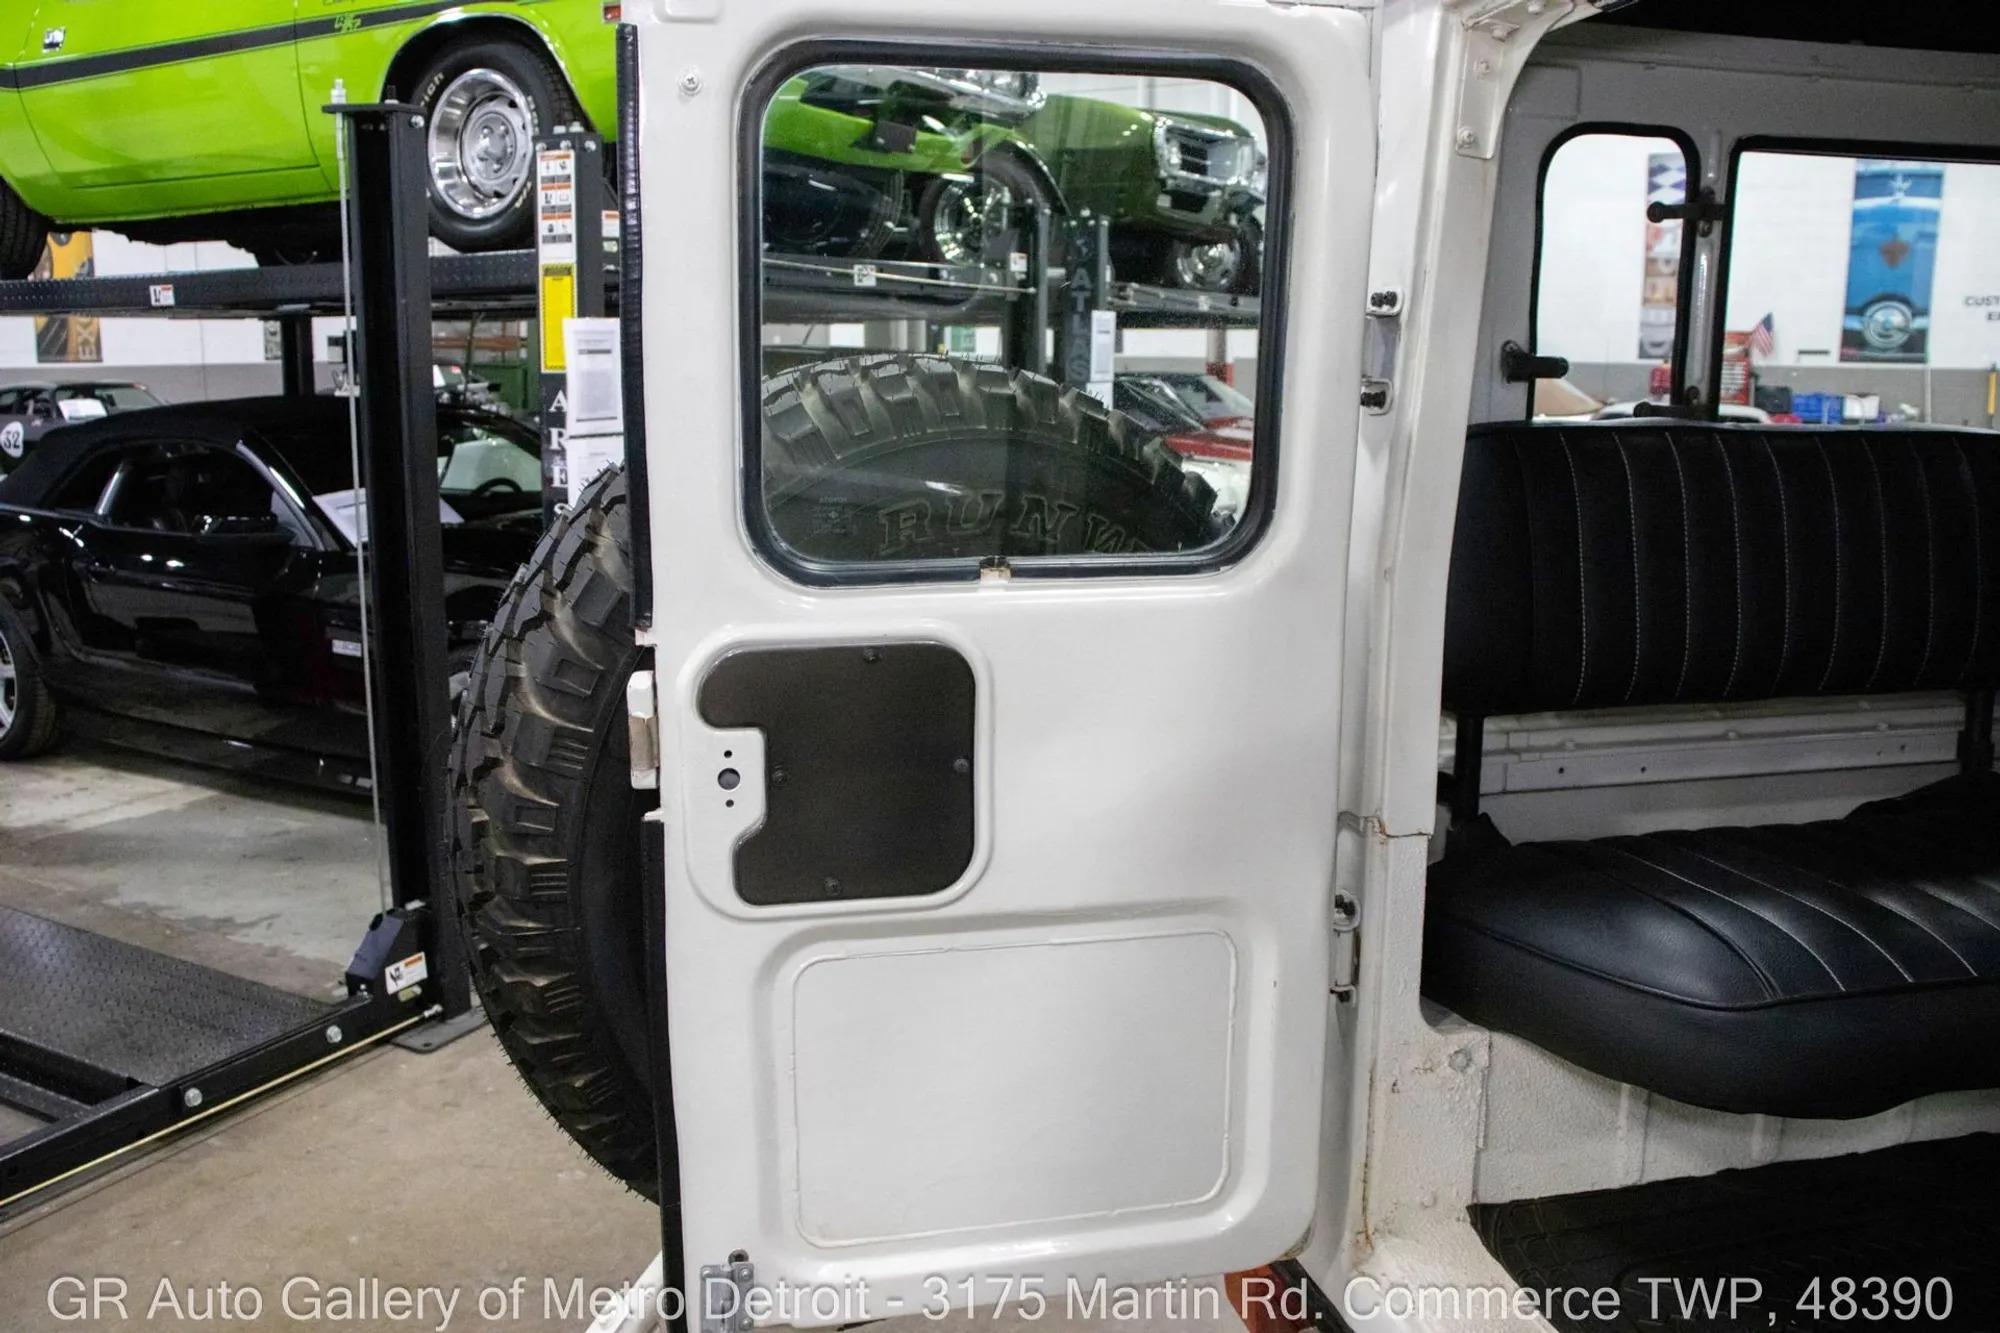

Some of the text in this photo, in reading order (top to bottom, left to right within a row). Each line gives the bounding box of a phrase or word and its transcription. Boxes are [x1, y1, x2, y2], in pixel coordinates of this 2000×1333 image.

[1070, 267, 1092, 383] ATLAS
[3, 430, 21, 450] 32
[876, 489, 1156, 556] RUNW
